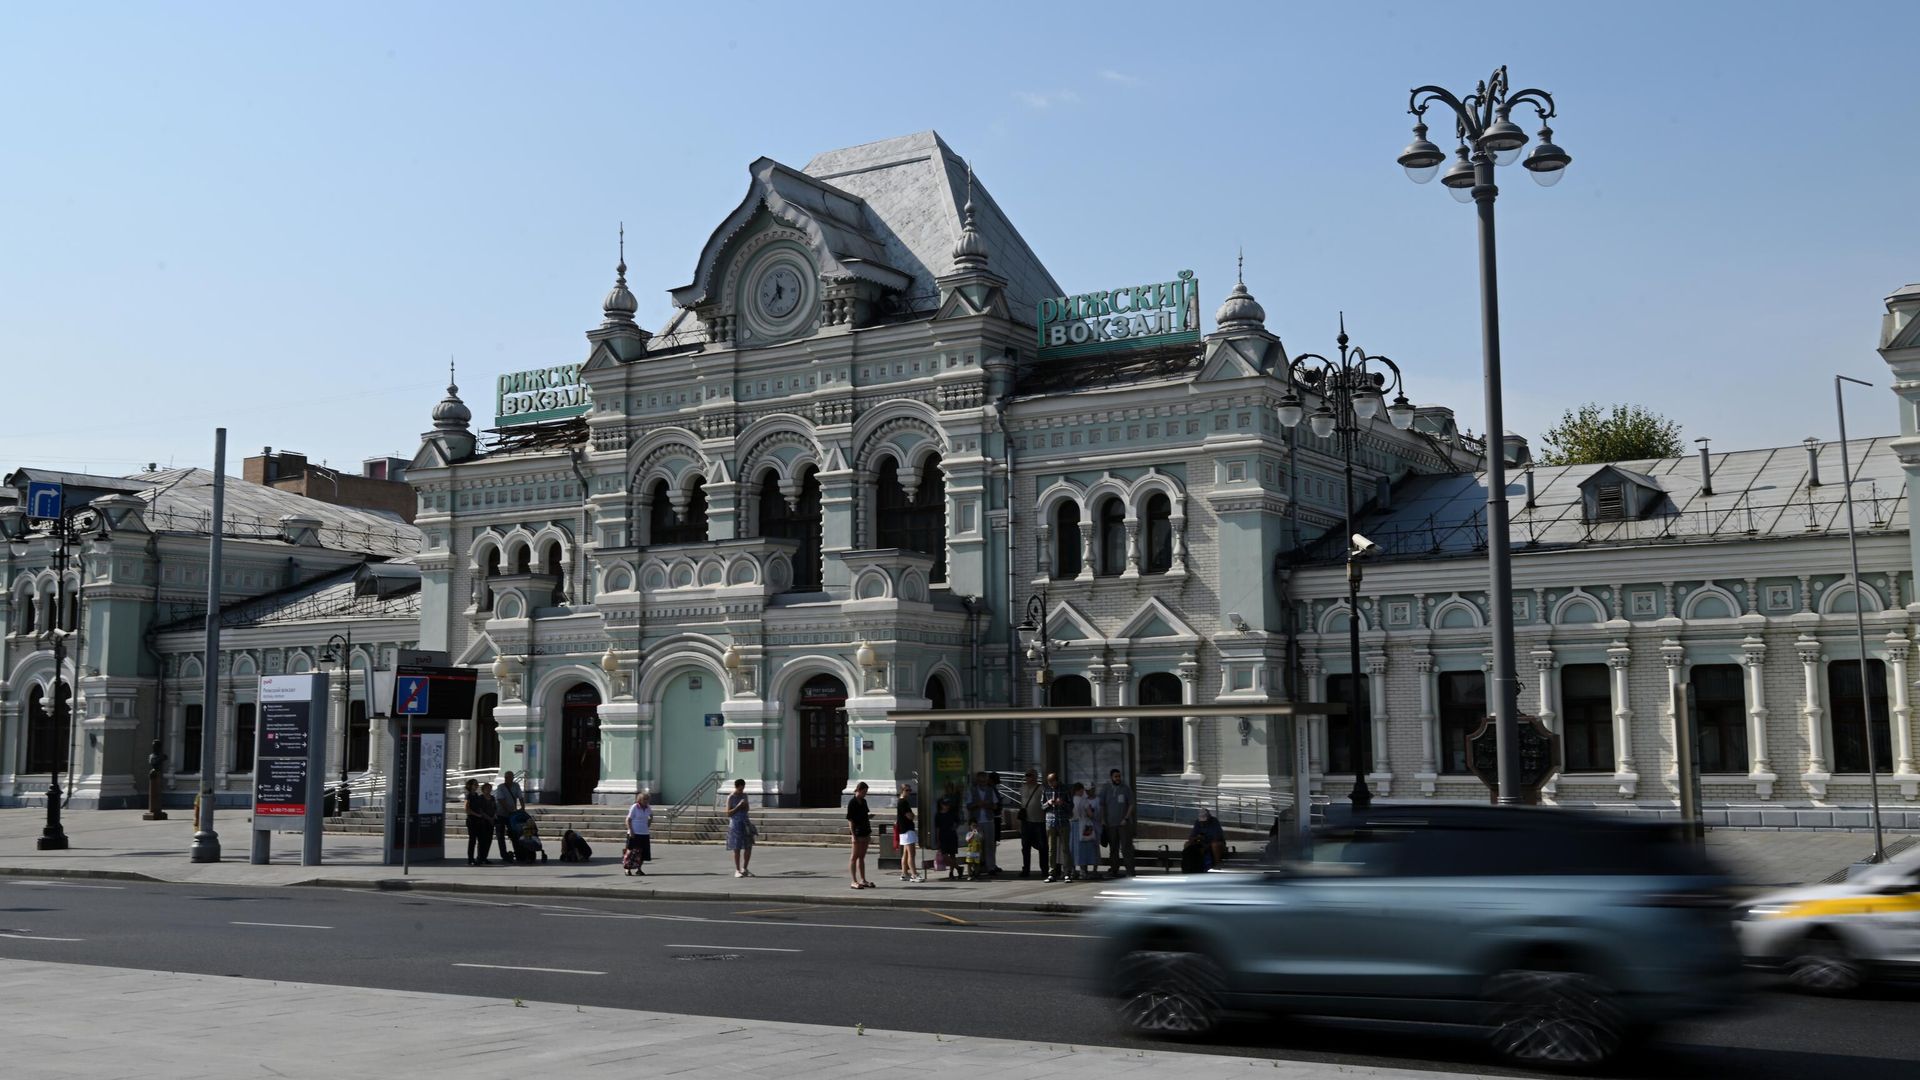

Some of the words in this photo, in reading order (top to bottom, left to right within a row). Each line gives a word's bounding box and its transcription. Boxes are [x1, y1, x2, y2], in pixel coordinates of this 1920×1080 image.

[1037, 269, 1199, 348] РИЖСКИЙ
[1051, 311, 1173, 347] ВОКЗАЛ
[496, 363, 592, 416] РИЖСК
[504, 386, 586, 414] ВОКЗАЛ
